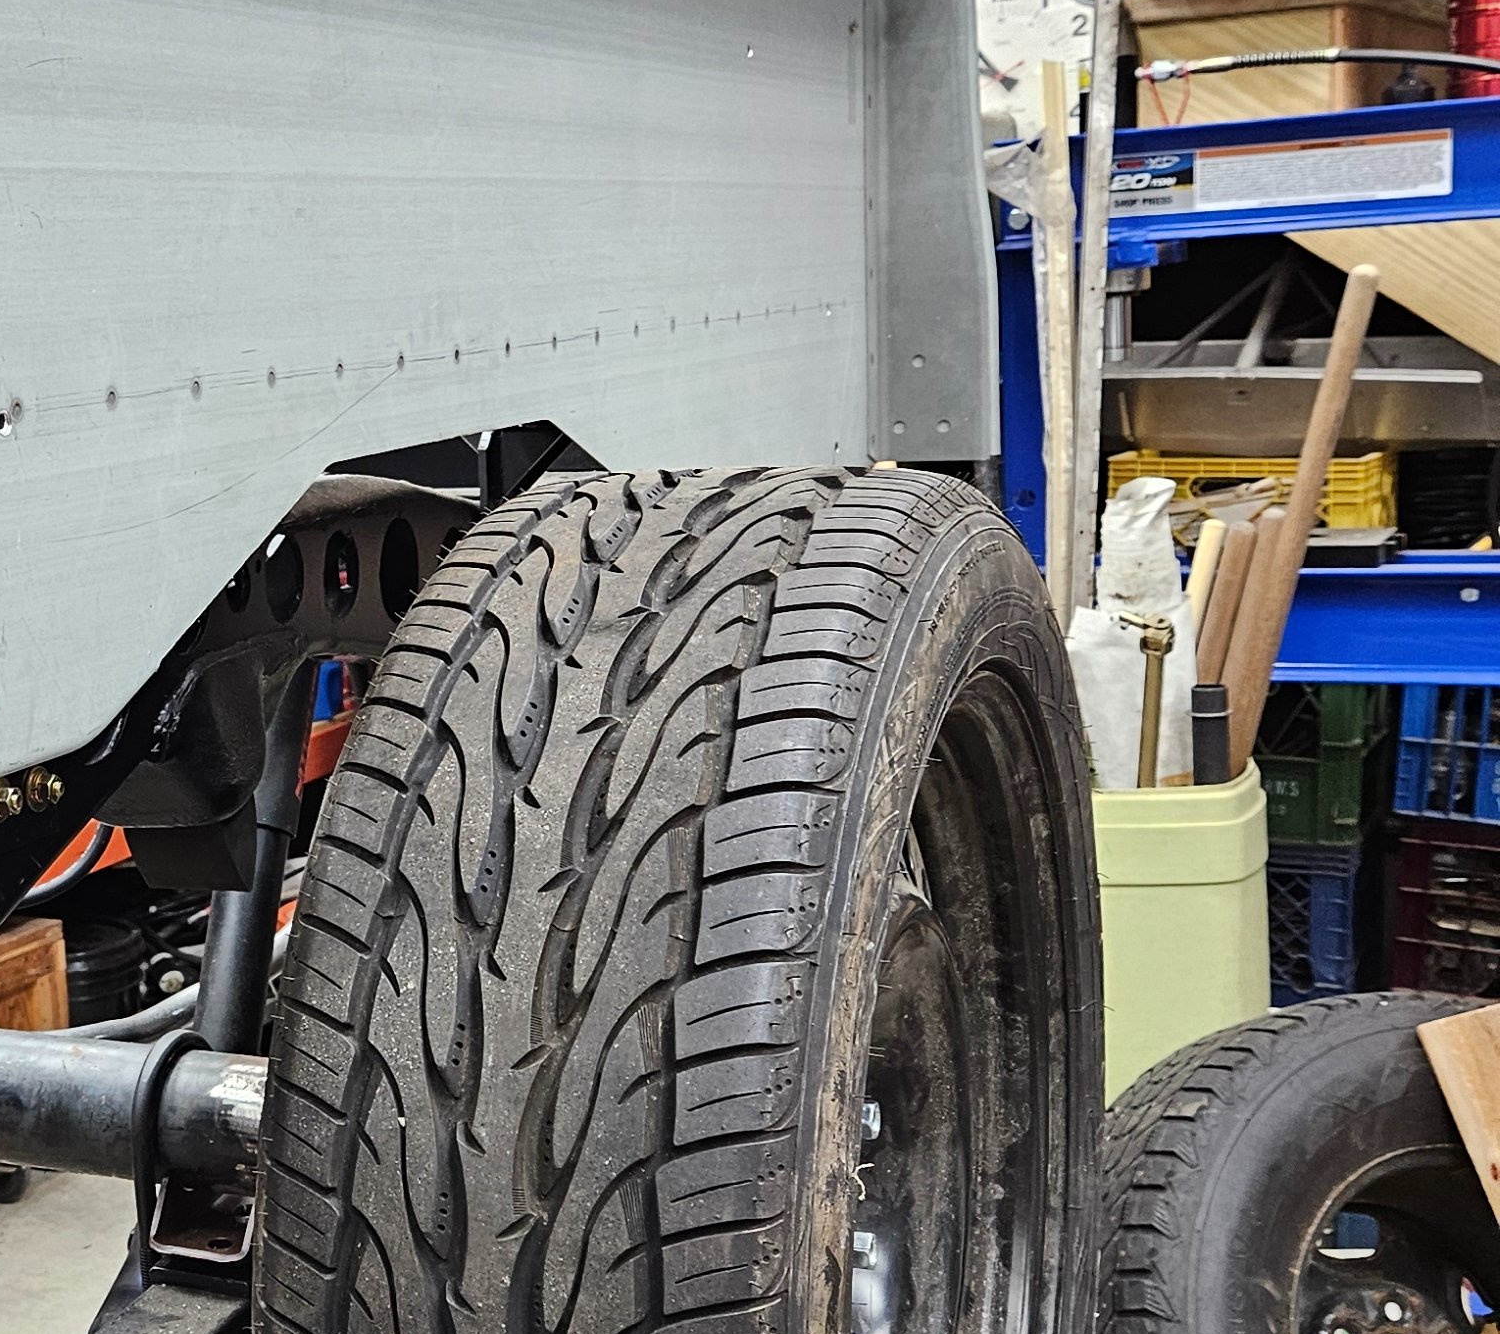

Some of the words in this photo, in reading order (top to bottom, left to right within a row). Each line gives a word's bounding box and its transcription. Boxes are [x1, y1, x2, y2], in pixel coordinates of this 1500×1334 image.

[1071, 14, 1088, 36] 2
[1110, 173, 1151, 191] 20
[1114, 198, 1139, 208] SHOP
[1143, 196, 1173, 205] PRESS
